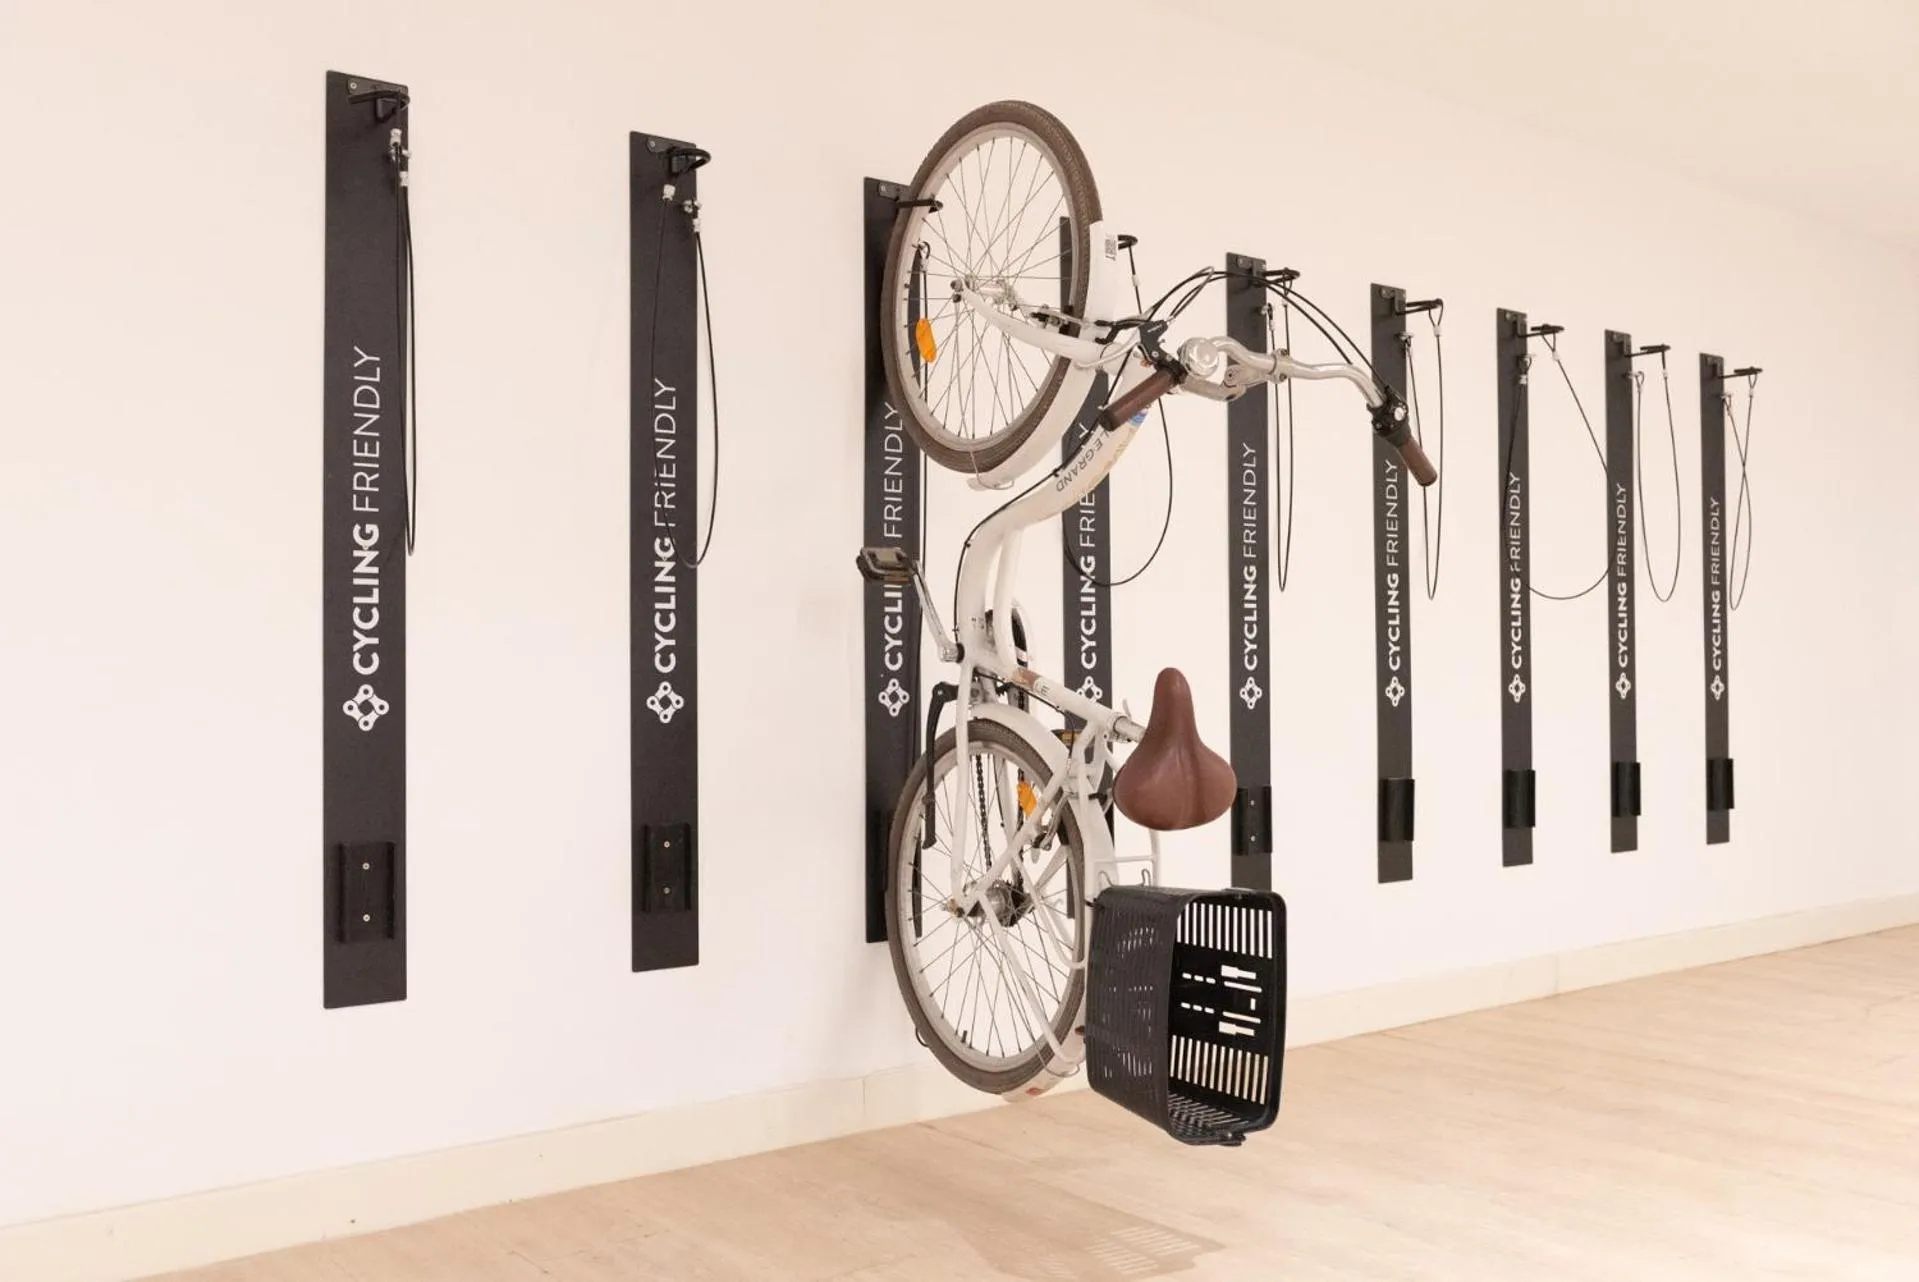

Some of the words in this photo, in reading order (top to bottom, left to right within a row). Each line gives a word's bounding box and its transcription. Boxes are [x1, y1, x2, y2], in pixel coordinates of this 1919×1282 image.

[353, 345, 381, 512] FRIENDLY
[654, 378, 677, 528] FRIENDLY
[883, 402, 903, 538] FRIENDLY
[1242, 442, 1257, 558] FRIENDLY
[1384, 459, 1399, 567] FRIENDLY
[1509, 471, 1521, 572] FRIENDLY
[1615, 482, 1627, 577] FRIENDLY
[1709, 496, 1721, 586] FRIENDLY
[352, 523, 380, 675] CYCLING
[654, 537, 677, 673] CYCLING
[883, 583, 903, 671] CYCLI
[1080, 555, 1097, 670] CYCLING
[1243, 565, 1258, 671] CYCLING
[1386, 573, 1401, 671] CYCLING
[1510, 577, 1522, 670] CYCLING
[1616, 582, 1628, 668] CYCLING
[1711, 590, 1722, 671] CYCLING
